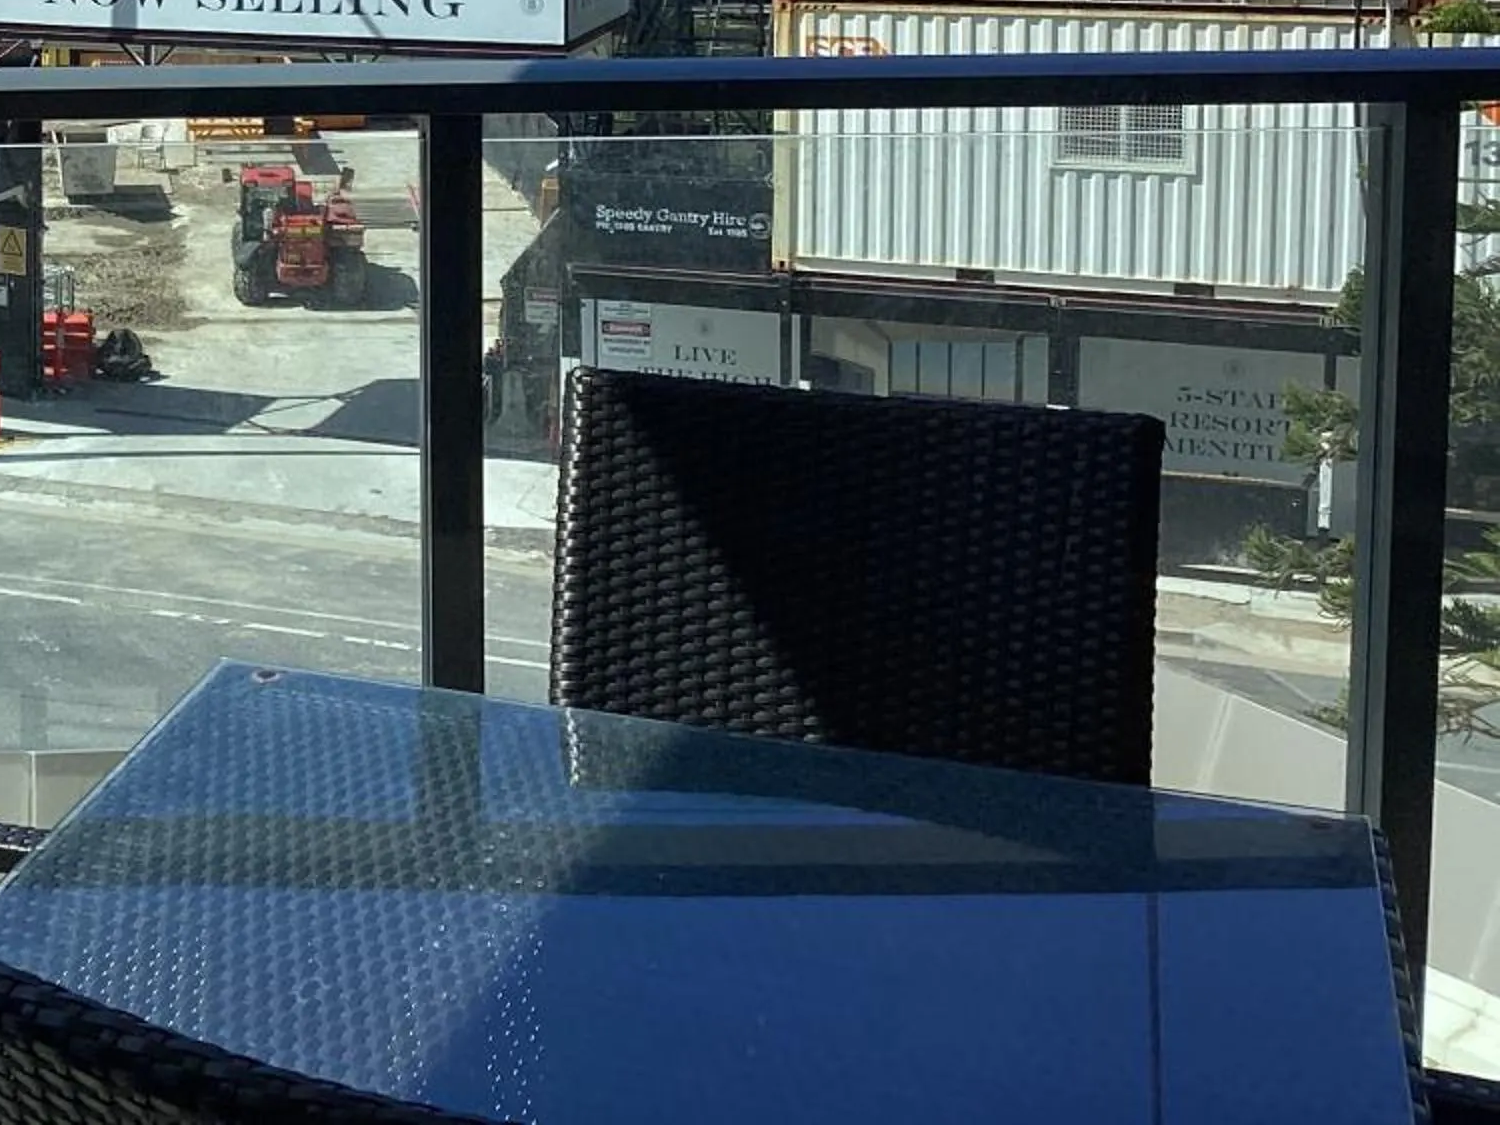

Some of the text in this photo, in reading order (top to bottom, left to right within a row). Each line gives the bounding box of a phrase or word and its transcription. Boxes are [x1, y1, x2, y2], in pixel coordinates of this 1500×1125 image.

[596, 204, 748, 228] Speedy Gantry Hire
[674, 344, 737, 366] LIVE
[1169, 411, 1291, 437] RESORT
